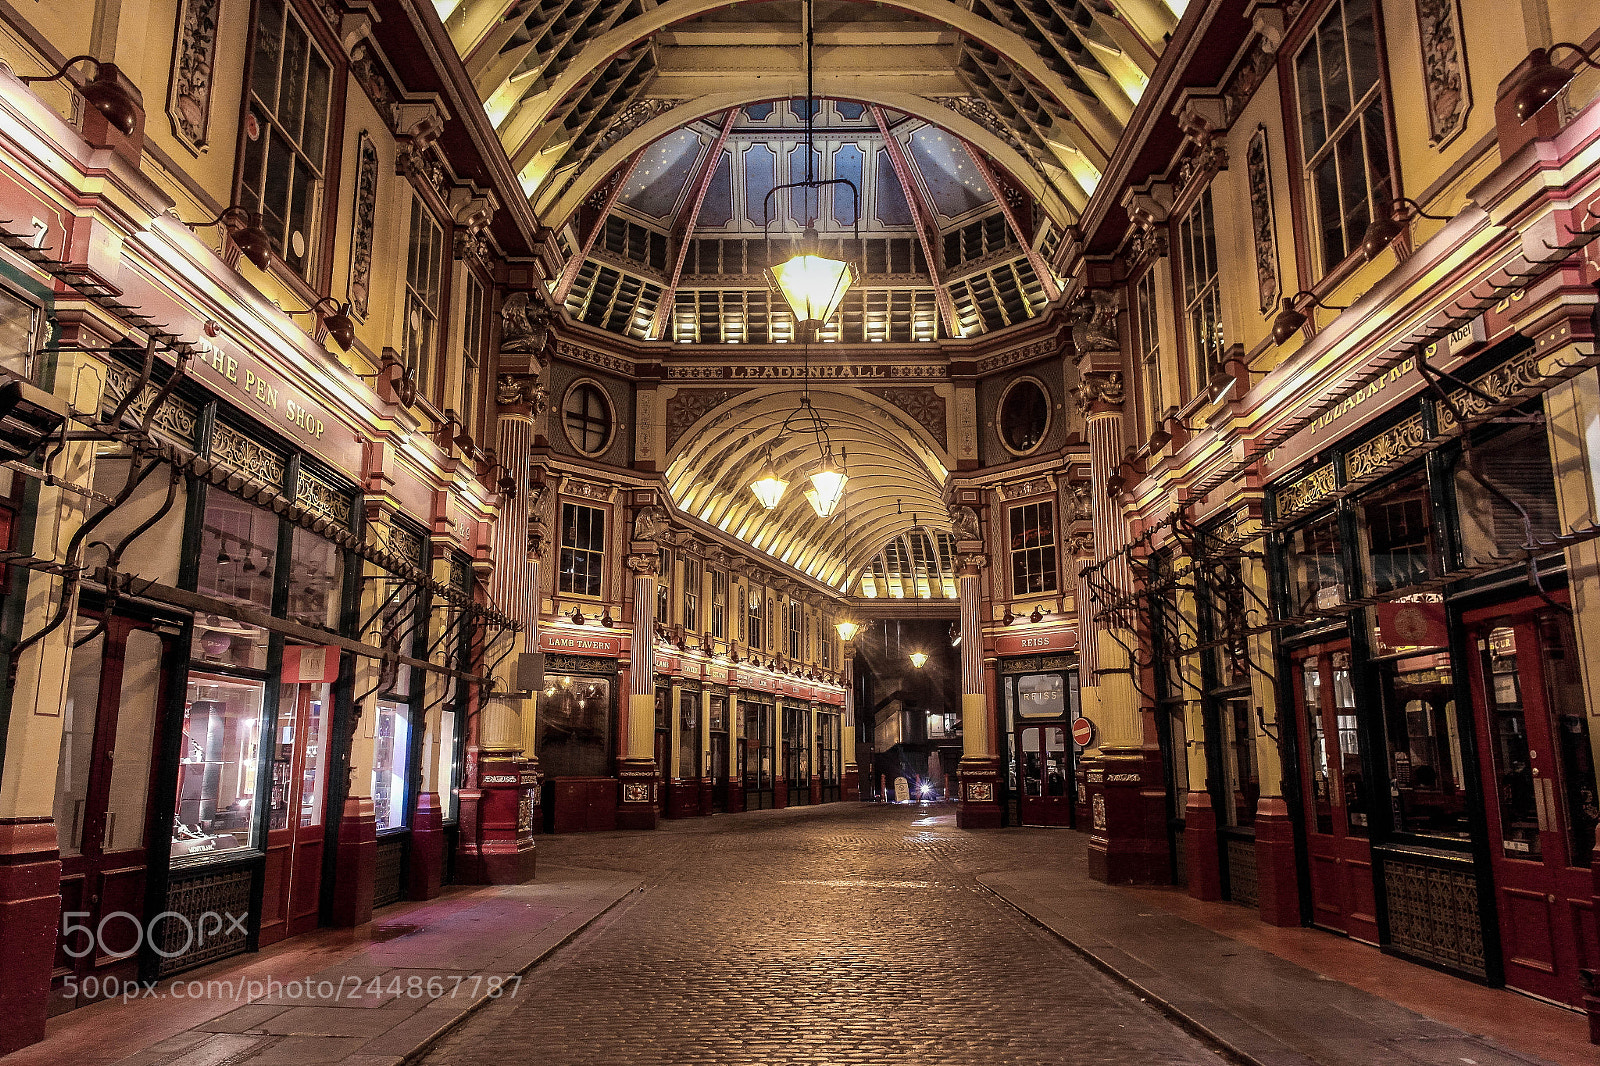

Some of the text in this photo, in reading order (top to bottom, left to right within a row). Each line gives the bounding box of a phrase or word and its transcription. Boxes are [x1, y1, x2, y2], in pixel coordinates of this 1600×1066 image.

[32, 215, 48, 249] 7
[1450, 323, 1471, 346] Abel
[730, 365, 885, 379] LEADENHALL
[199, 335, 325, 440] THE PEN SHOP
[1310, 342, 1437, 435] PIZZAEXPRES
[548, 637, 611, 650] LAMB TAVERN
[1021, 637, 1050, 647] REISS
[1023, 691, 1058, 701] REISS
